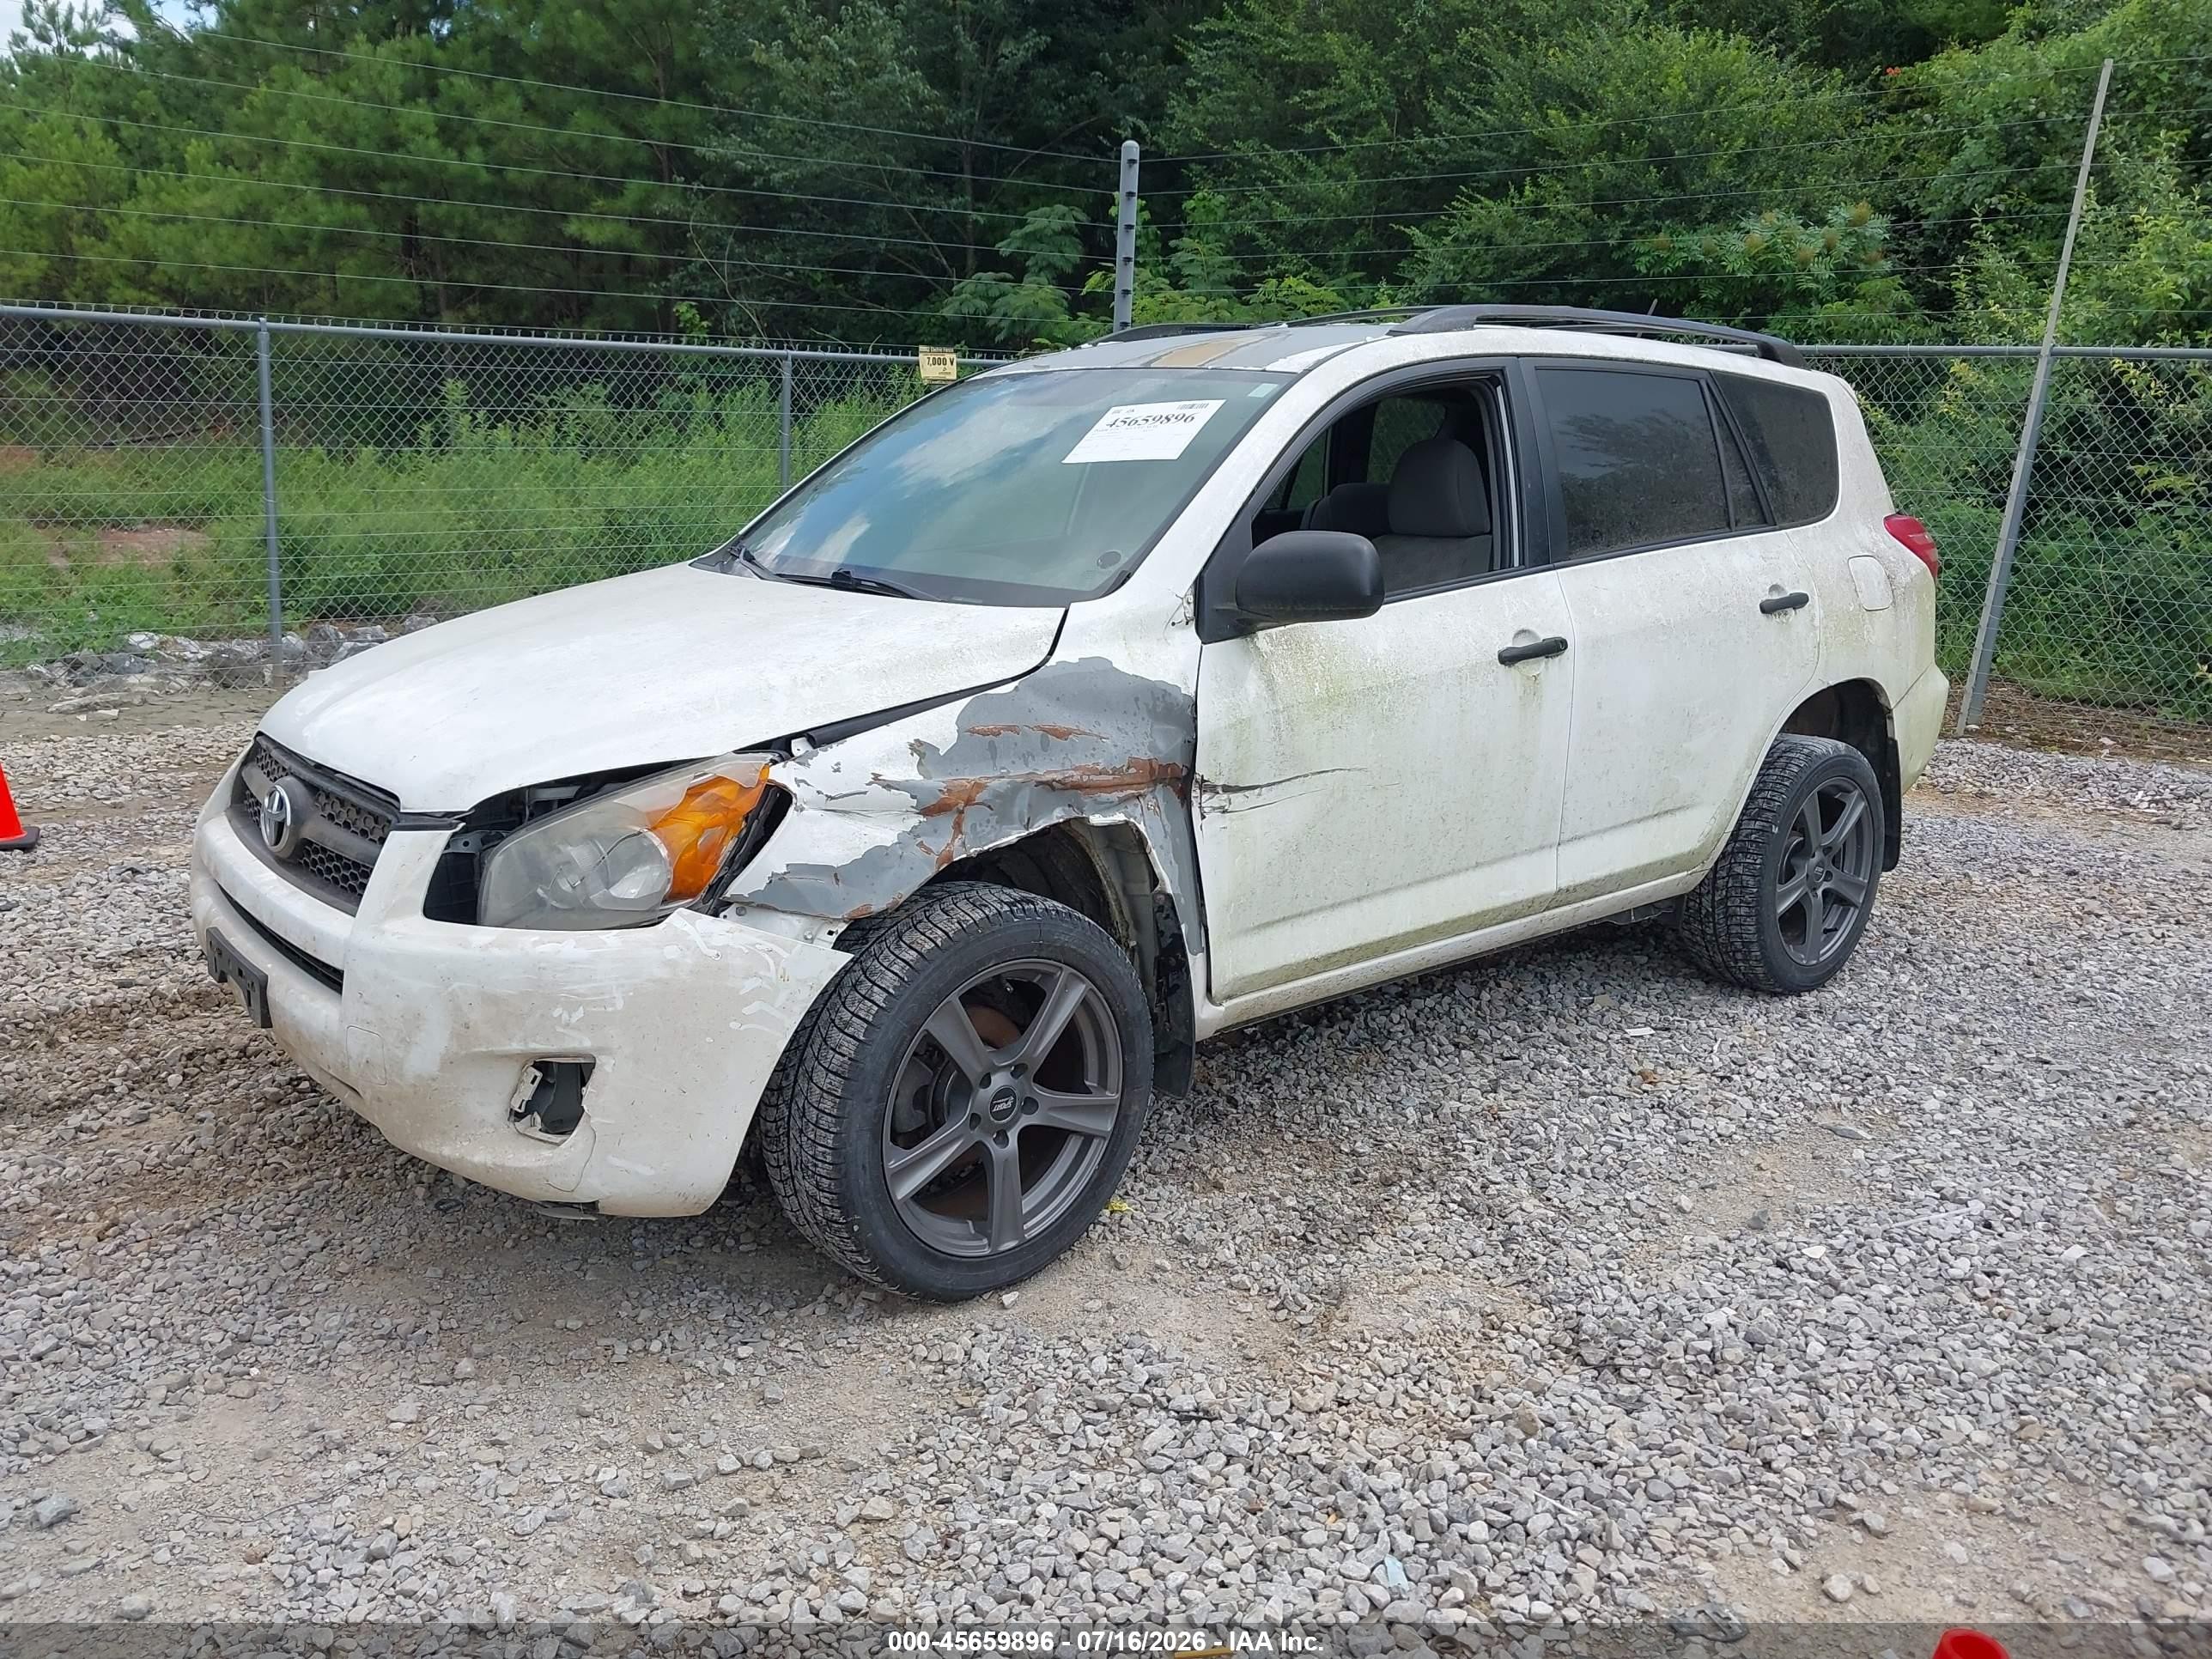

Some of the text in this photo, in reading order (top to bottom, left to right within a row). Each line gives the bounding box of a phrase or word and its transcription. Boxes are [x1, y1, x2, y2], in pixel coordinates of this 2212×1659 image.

[927, 356, 955, 367] 7,000 V
[1105, 412, 1200, 428] 45659896
